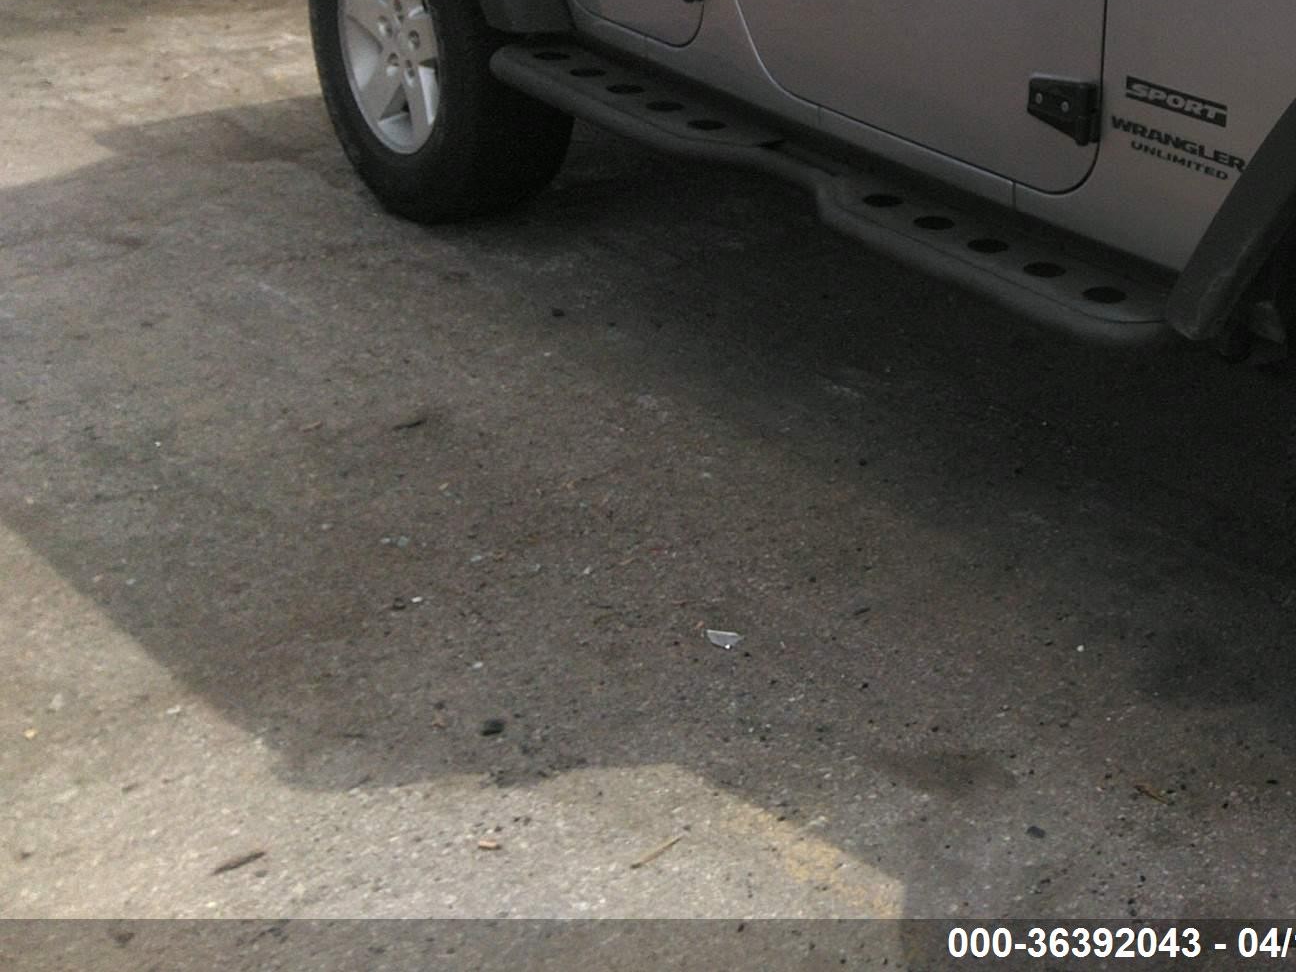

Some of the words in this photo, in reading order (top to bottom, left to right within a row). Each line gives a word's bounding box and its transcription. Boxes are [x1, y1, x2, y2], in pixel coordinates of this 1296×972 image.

[1128, 82, 1228, 121] SPORT
[1111, 114, 1246, 173] WRANGLER
[1130, 140, 1229, 181] UNLIMITED
